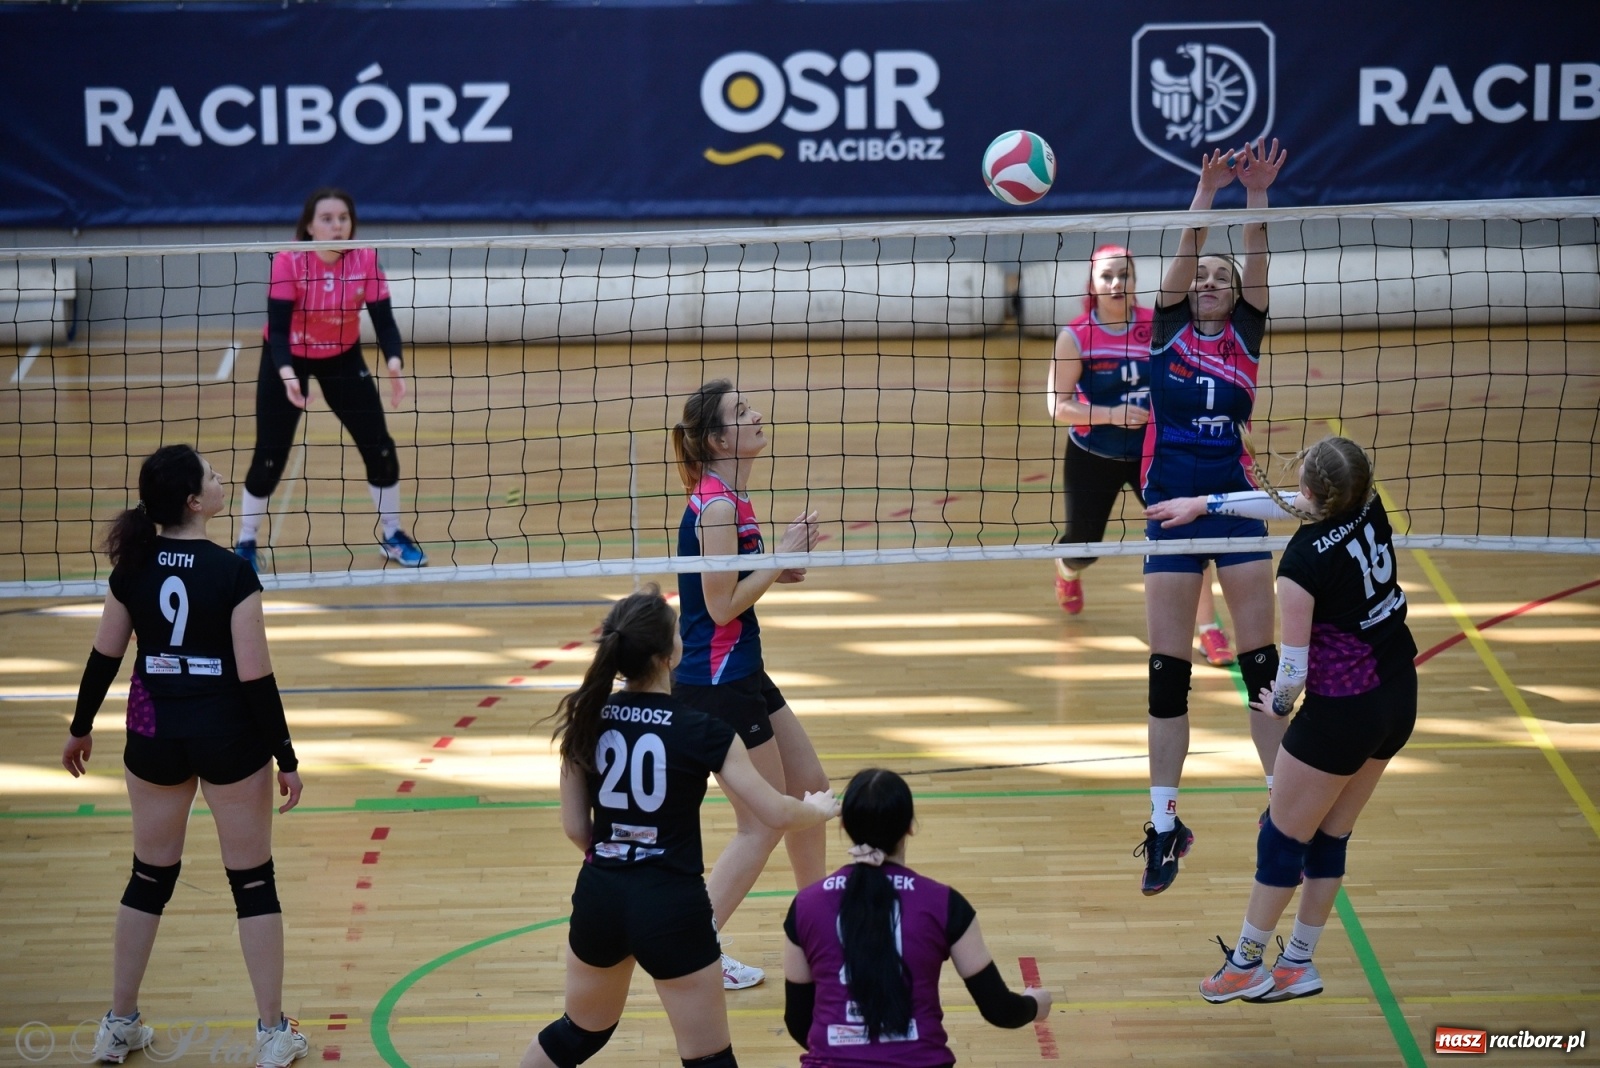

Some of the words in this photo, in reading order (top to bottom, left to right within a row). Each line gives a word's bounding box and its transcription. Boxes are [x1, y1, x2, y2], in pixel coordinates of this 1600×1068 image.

[84, 62, 513, 147] RACIBÓRZ
[1358, 64, 1600, 126] RACIB
[798, 130, 945, 163] RACIBÓRZ
[323, 272, 335, 292] 3
[1121, 361, 1140, 386] 4
[1196, 376, 1215, 410] 7
[157, 551, 195, 568] GUTH
[1345, 522, 1393, 599] 16
[159, 575, 190, 647] 9
[600, 704, 673, 726] GROBOSZ
[595, 728, 668, 813] 20
